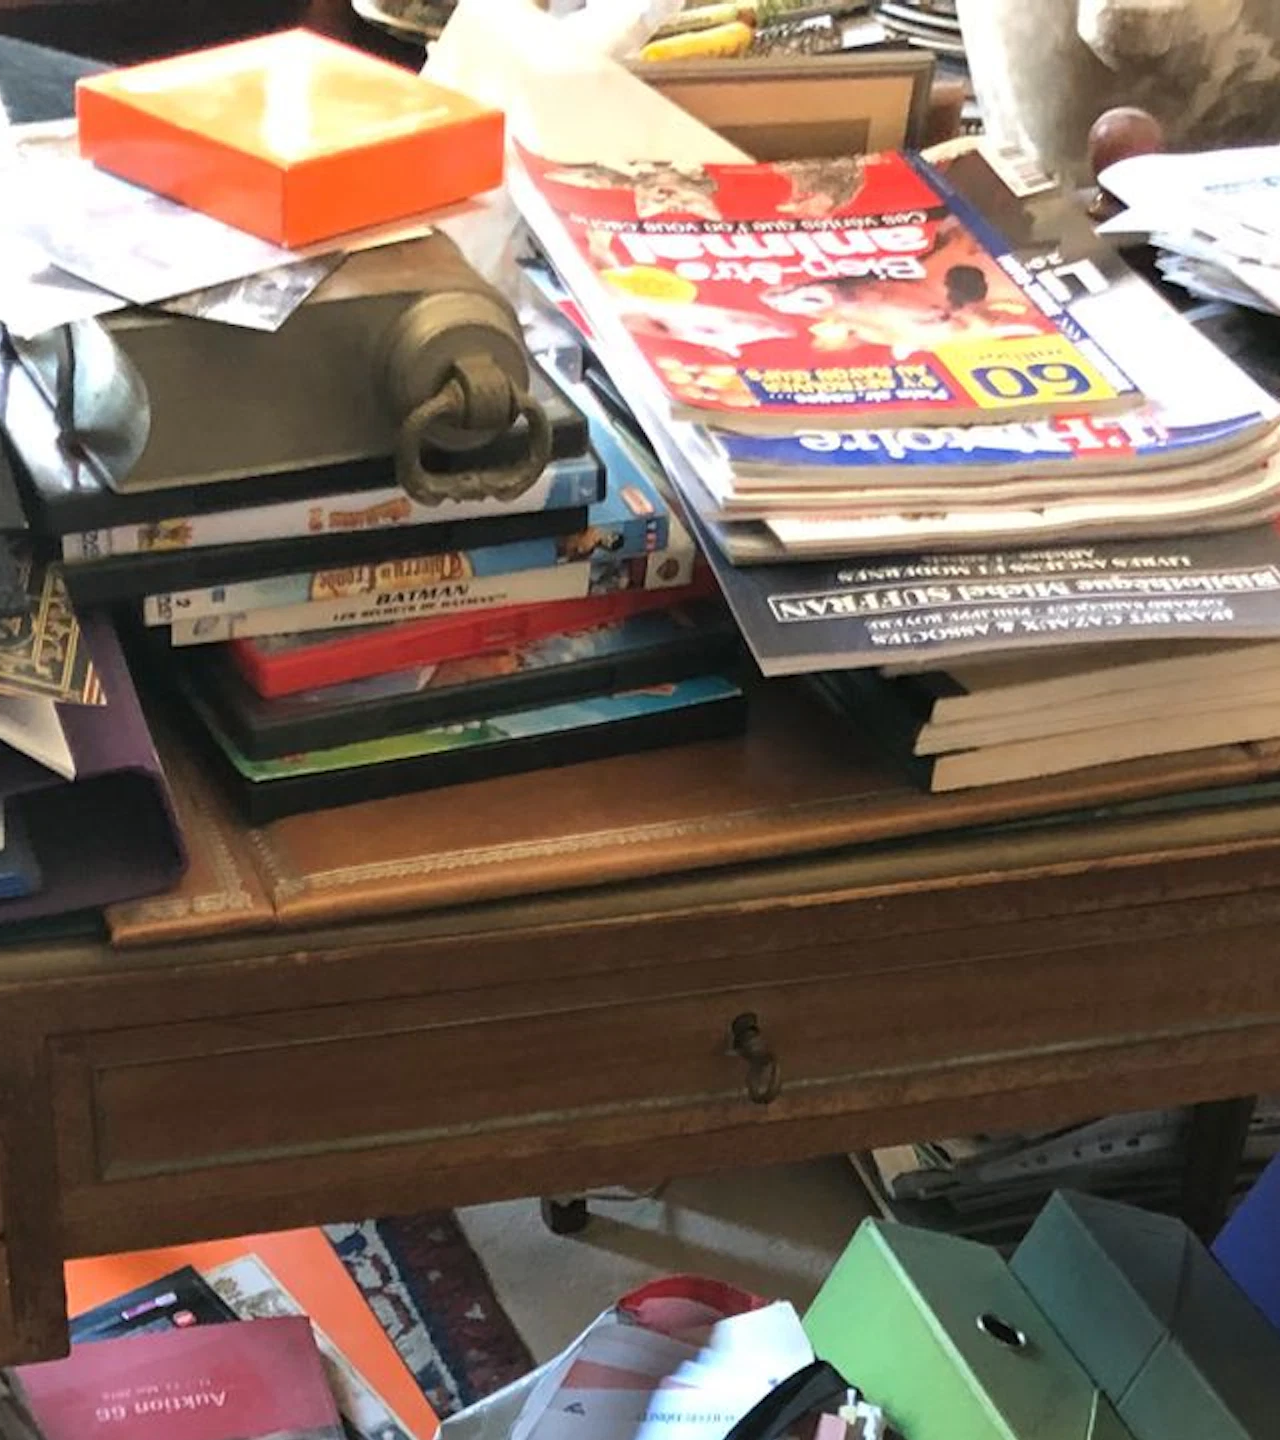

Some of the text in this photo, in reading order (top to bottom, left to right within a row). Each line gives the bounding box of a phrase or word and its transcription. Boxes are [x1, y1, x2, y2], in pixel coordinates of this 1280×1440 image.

[619, 226, 927, 263] animal
[676, 255, 925, 282] Bien-être
[971, 362, 1090, 399] 60
[375, 585, 469, 604] BATMAN
[779, 572, 1278, 619] Bibliothèque Michel SUFFRAN
[95, 1390, 226, 1422] Auktion 66
